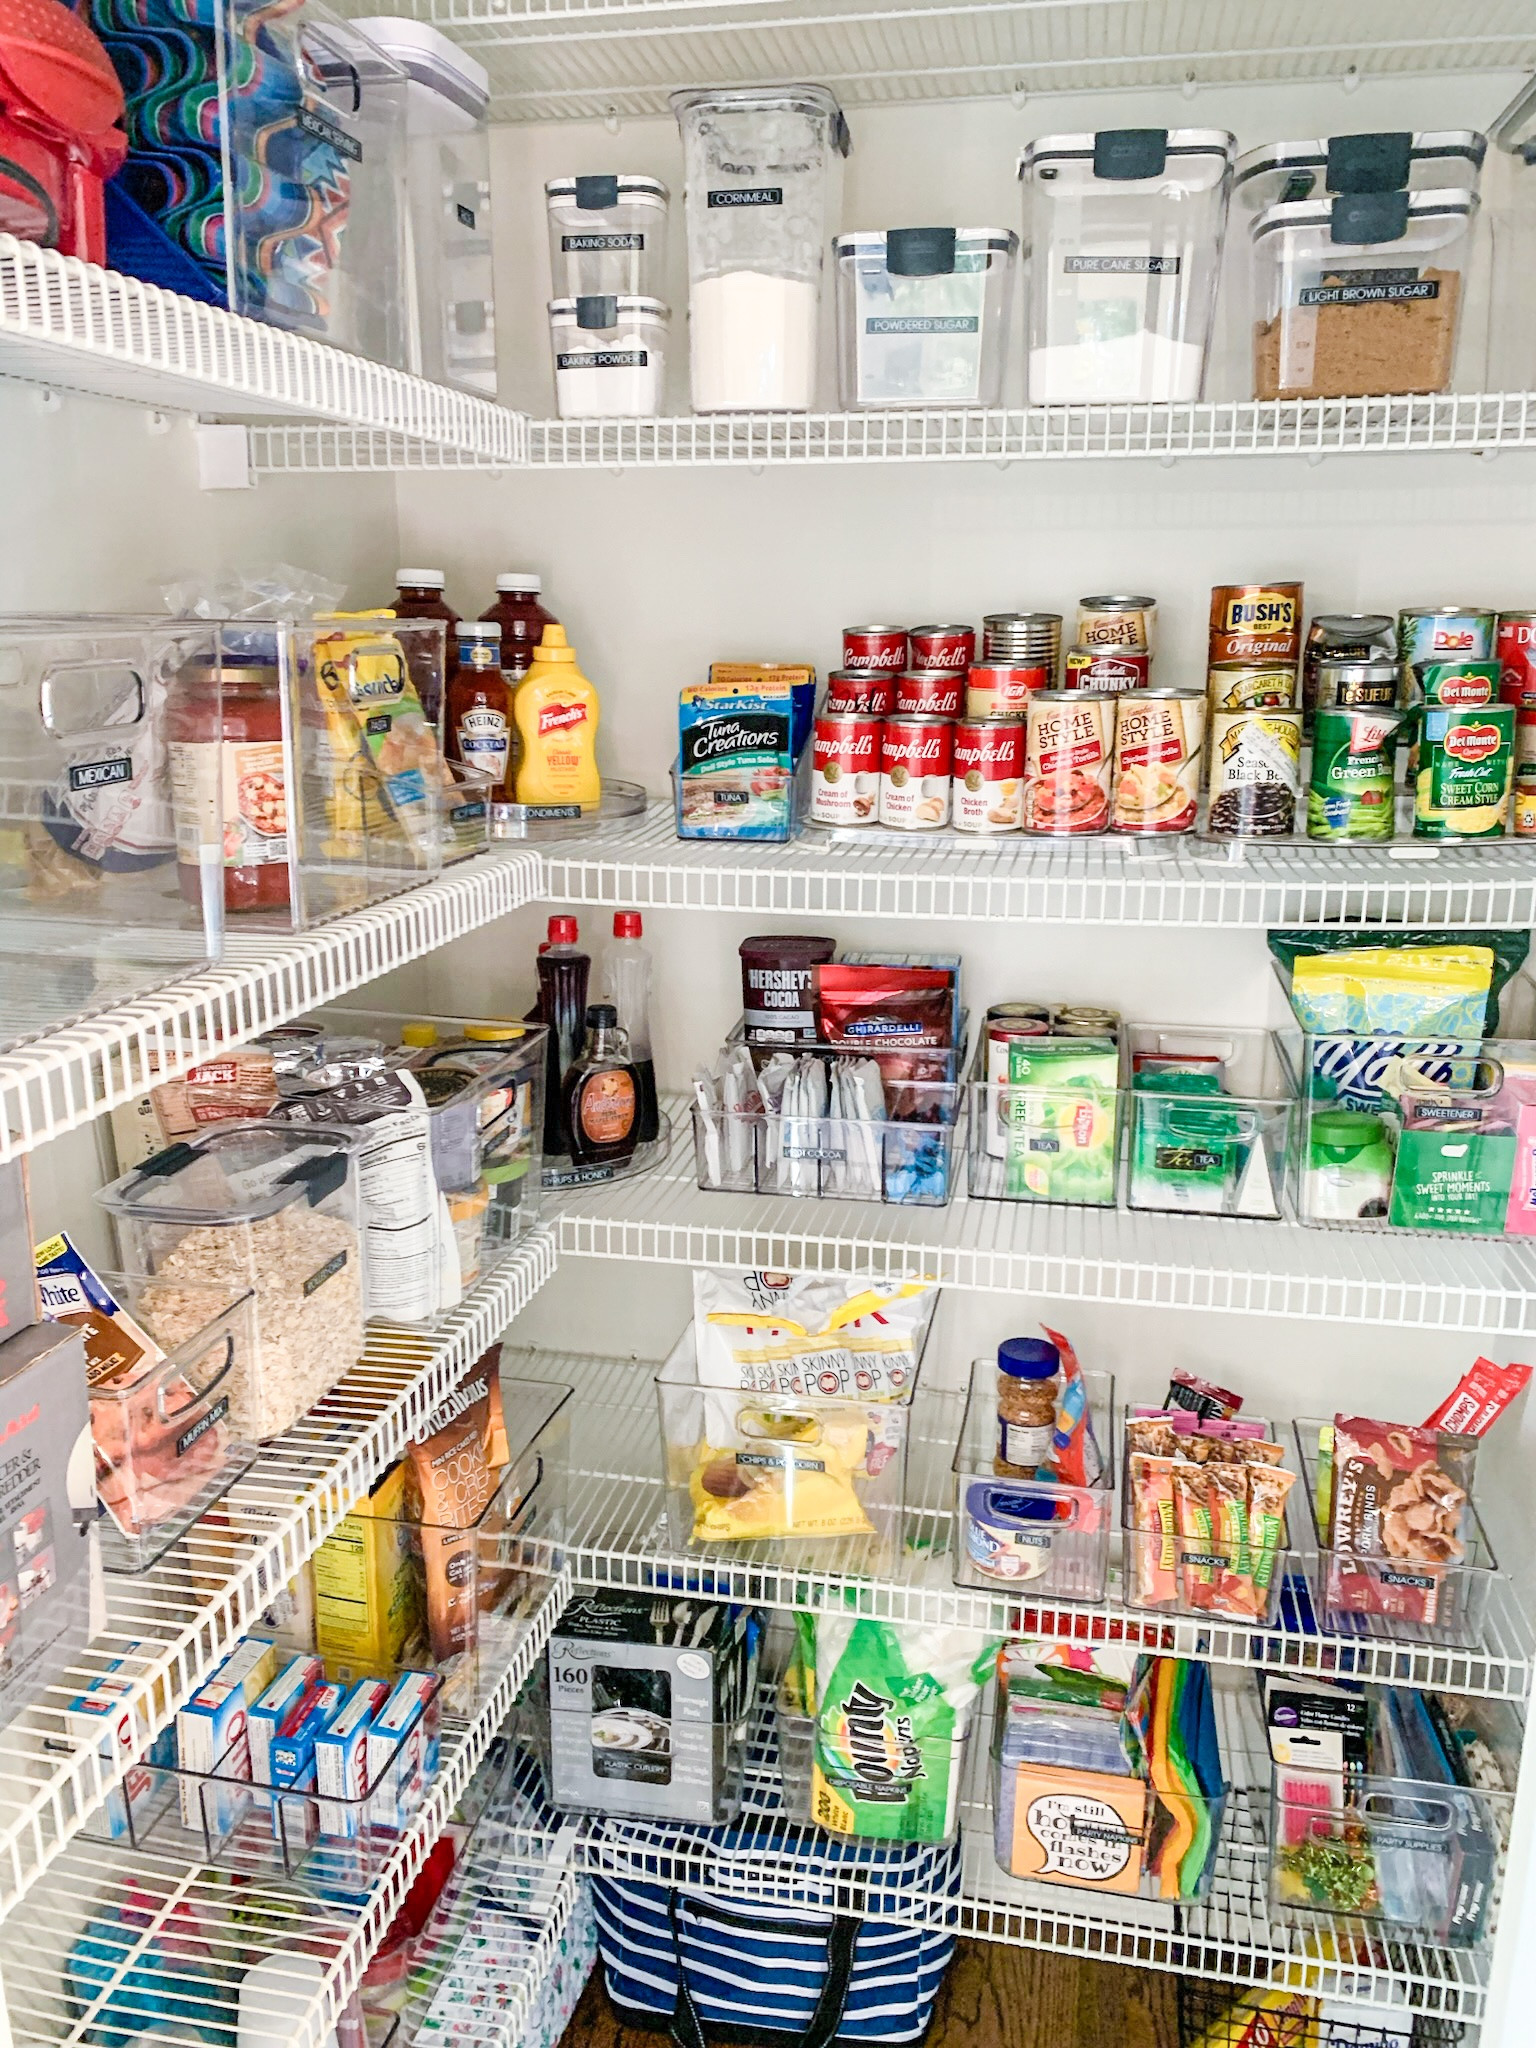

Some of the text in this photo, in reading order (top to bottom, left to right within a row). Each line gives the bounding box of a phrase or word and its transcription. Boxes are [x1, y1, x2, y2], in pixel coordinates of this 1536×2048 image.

[716, 191, 773, 204] CORNMEAL
[569, 237, 635, 249] BAKING SODA
[1072, 259, 1170, 271] PURE CANE SUGAR
[1308, 285, 1429, 302] LIGHT BROWN SUGAR
[874, 320, 969, 331] POWDERED SUGAR
[562, 352, 640, 366] BAKING POWDER
[1231, 602, 1293, 625] BUSH'S
[1085, 621, 1138, 644] HOME
[1433, 630, 1475, 648] Dole
[1226, 638, 1294, 656] Original
[844, 646, 904, 671] Campbell's
[912, 646, 965, 671] ampbell's
[1080, 674, 1138, 692] CHUNKY
[1003, 684, 1025, 696] IGA
[1443, 685, 1488, 698] Del Monte
[706, 699, 768, 711] StarKist
[540, 707, 583, 730] French's
[990, 711, 1027, 719] CHICKE
[1119, 710, 1172, 733] HOME
[468, 716, 502, 728] HEINZ
[1037, 712, 1093, 736] HOME
[700, 720, 740, 739] Tuna
[1120, 724, 1174, 746] STYLE
[1038, 725, 1096, 749] STYLE
[1449, 735, 1497, 748] Del Monte
[692, 730, 780, 758] Creations
[882, 734, 942, 761] ampbell's
[547, 755, 580, 767] YELLOW
[736, 757, 757, 765] Tuna
[78, 764, 125, 785] MEXICAN
[1228, 769, 1261, 781] Black
[1332, 767, 1377, 780] Green
[818, 788, 839, 799] Cream
[1440, 781, 1500, 795] SWEET CORN
[720, 793, 741, 803] TUNA
[815, 797, 851, 809] Mushroom
[885, 792, 905, 803] Cream
[961, 797, 988, 808] Chicken
[1440, 793, 1500, 806] CREAM STYLE
[886, 801, 912, 813] Chicken
[963, 806, 984, 817] Broth
[763, 990, 801, 1009] COCOA
[846, 1022, 921, 1036] GHIRARDELLI
[874, 1036, 938, 1047] CHOCOLATE
[195, 1070, 234, 1082] JACK
[1421, 1108, 1475, 1119] SWEETENER
[1036, 1140, 1054, 1151] TEA
[1198, 1155, 1216, 1165] TEA
[543, 1170, 609, 1187] SYRUPS & HONEY
[1431, 1170, 1474, 1183] SPRINKLE
[1416, 1181, 1491, 1195] SWEET MOMENTS
[801, 1352, 848, 1374] SKINNY
[1443, 1396, 1477, 1432] CHOMPS
[181, 1406, 224, 1451] MUFFIN MIX
[743, 1454, 819, 1471] CHIPS & POCORN
[1363, 1484, 1377, 1521] RINDS
[1022, 1536, 1044, 1546] NUTS
[1188, 1554, 1227, 1567] SNACKS
[1387, 1574, 1427, 1587] SNACKS
[578, 1615, 622, 1627] PLASTIC
[553, 1666, 588, 1685] 160
[557, 1684, 585, 1694] Pieces
[1347, 1703, 1356, 1713] 12
[604, 1760, 633, 1770] PLASTIC
[818, 1791, 831, 1821] 200
[1074, 1804, 1105, 1817] still
[1077, 1828, 1102, 1838] PARTY
[1376, 1835, 1443, 1852] PARTY SUPPLIES
[1050, 1840, 1122, 1864] flashes
[1056, 1855, 1112, 1875] now
